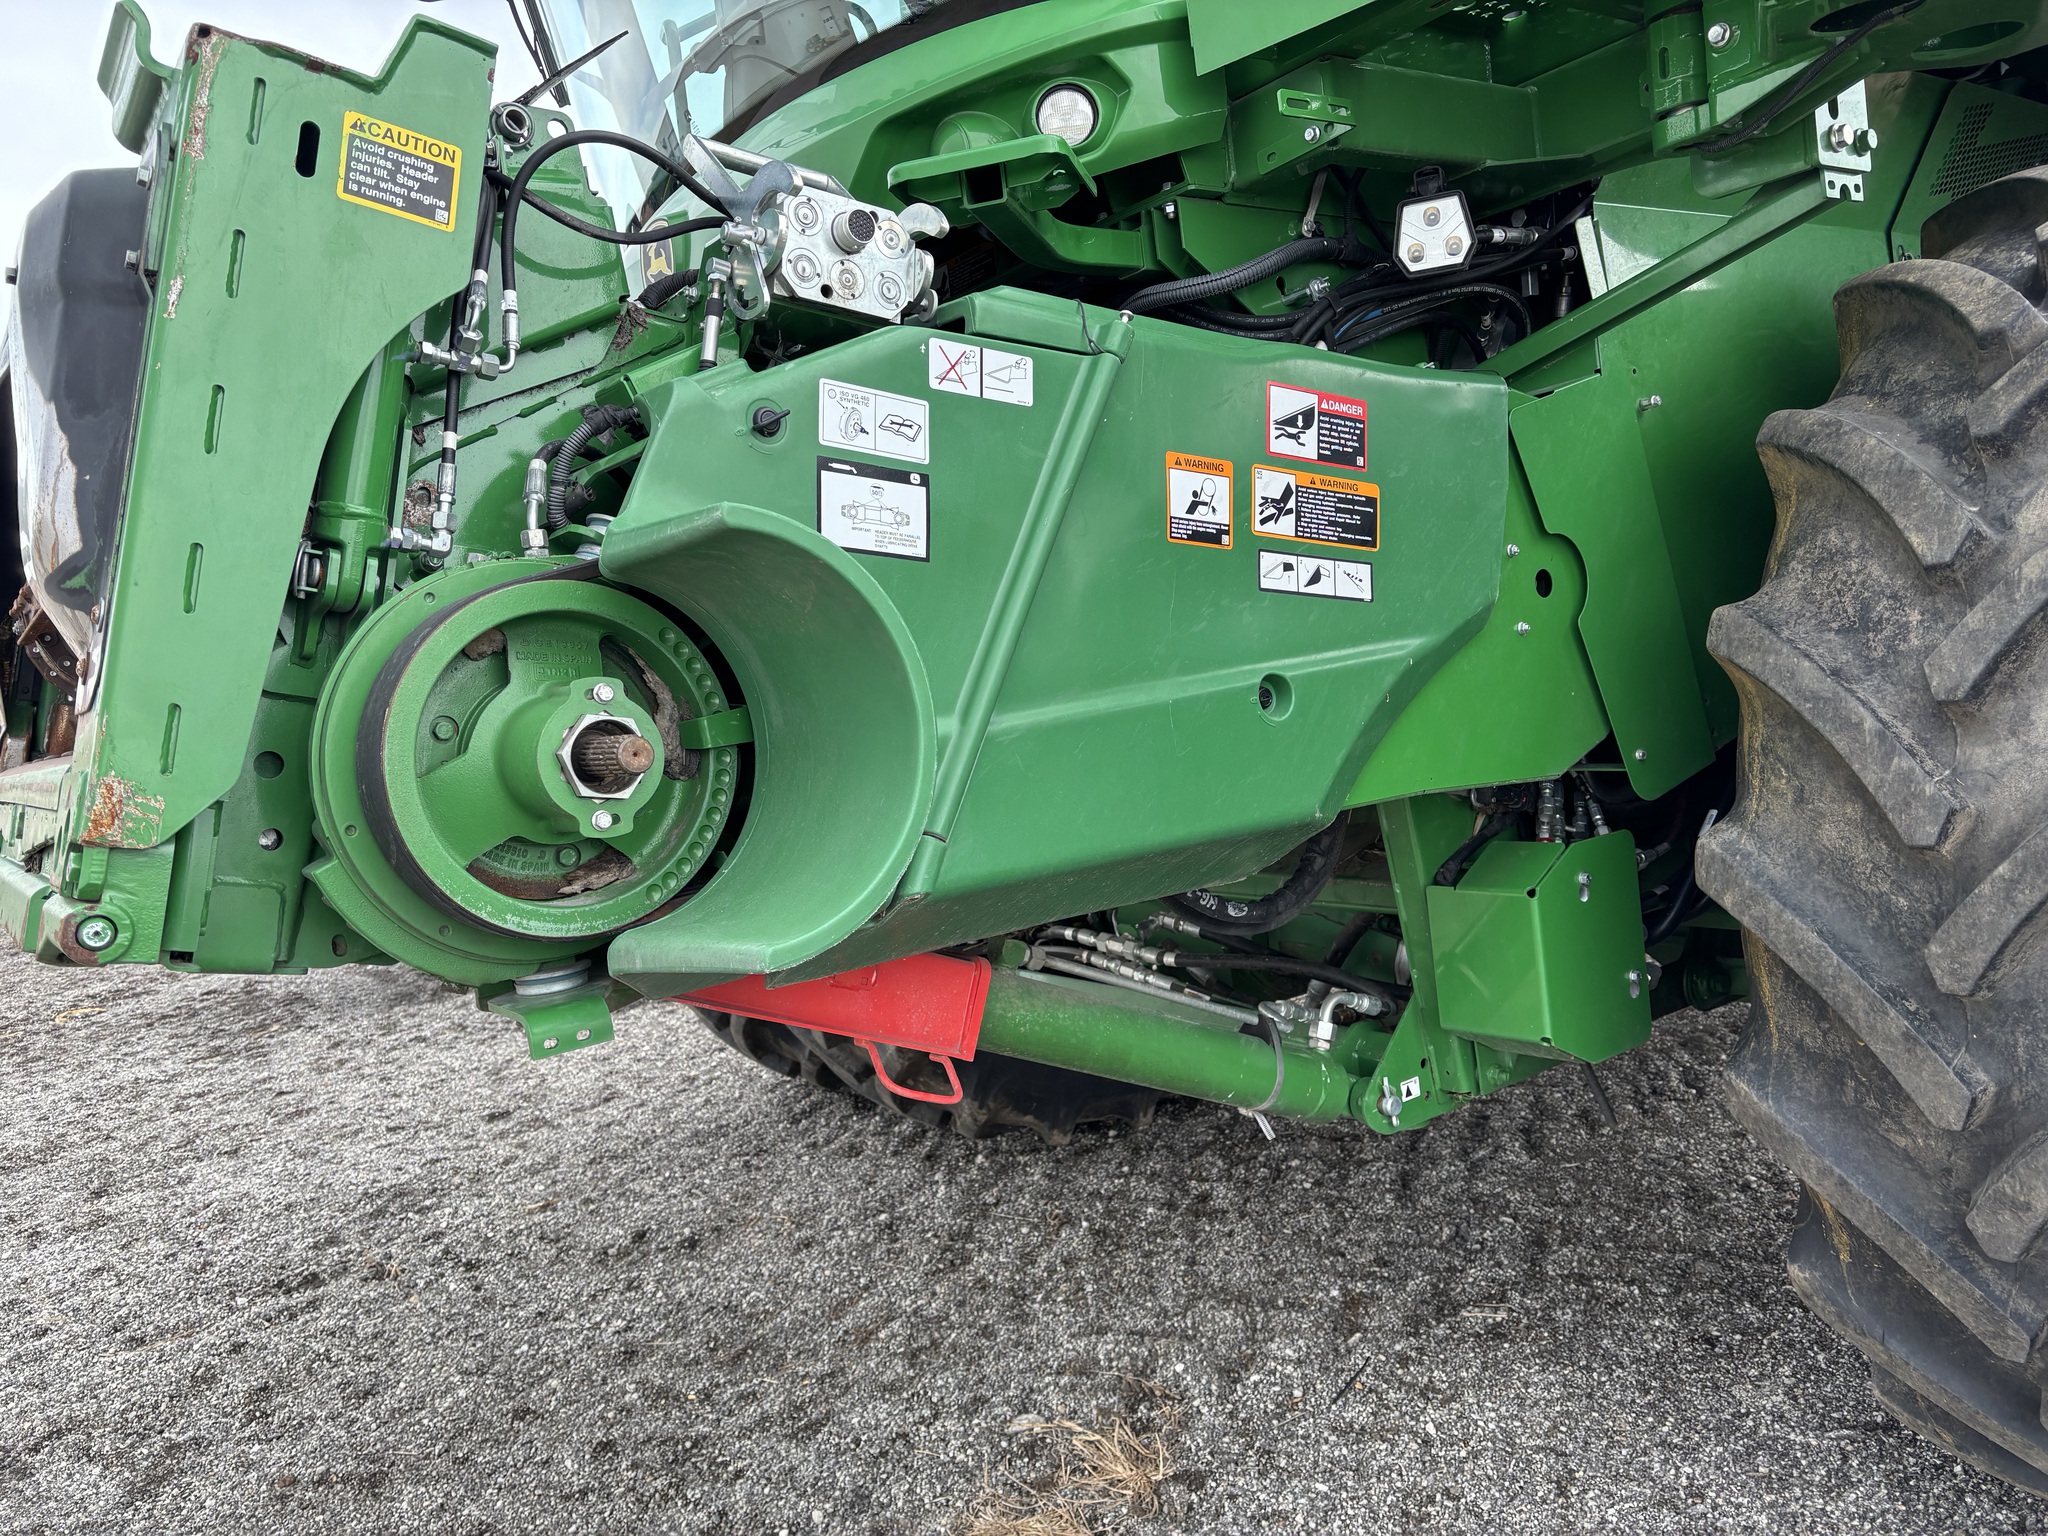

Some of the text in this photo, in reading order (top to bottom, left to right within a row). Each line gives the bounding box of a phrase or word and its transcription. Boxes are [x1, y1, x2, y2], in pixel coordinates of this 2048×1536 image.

[368, 122, 456, 163] CAUTION
[353, 138, 434, 173] Avoid crushing
[351, 162, 420, 190] can tilt. Stay
[352, 149, 439, 184] injuries. Header
[349, 171, 446, 208] clear when engine
[349, 181, 406, 207] is running.
[839, 396, 869, 407] SYNTHETIC
[1329, 400, 1363, 416] DANGER
[1184, 458, 1224, 472] WARNING
[1319, 478, 1359, 492] WARNING
[516, 652, 592, 664] MADE IN SPAIN
[520, 861, 549, 872] SPAIN
